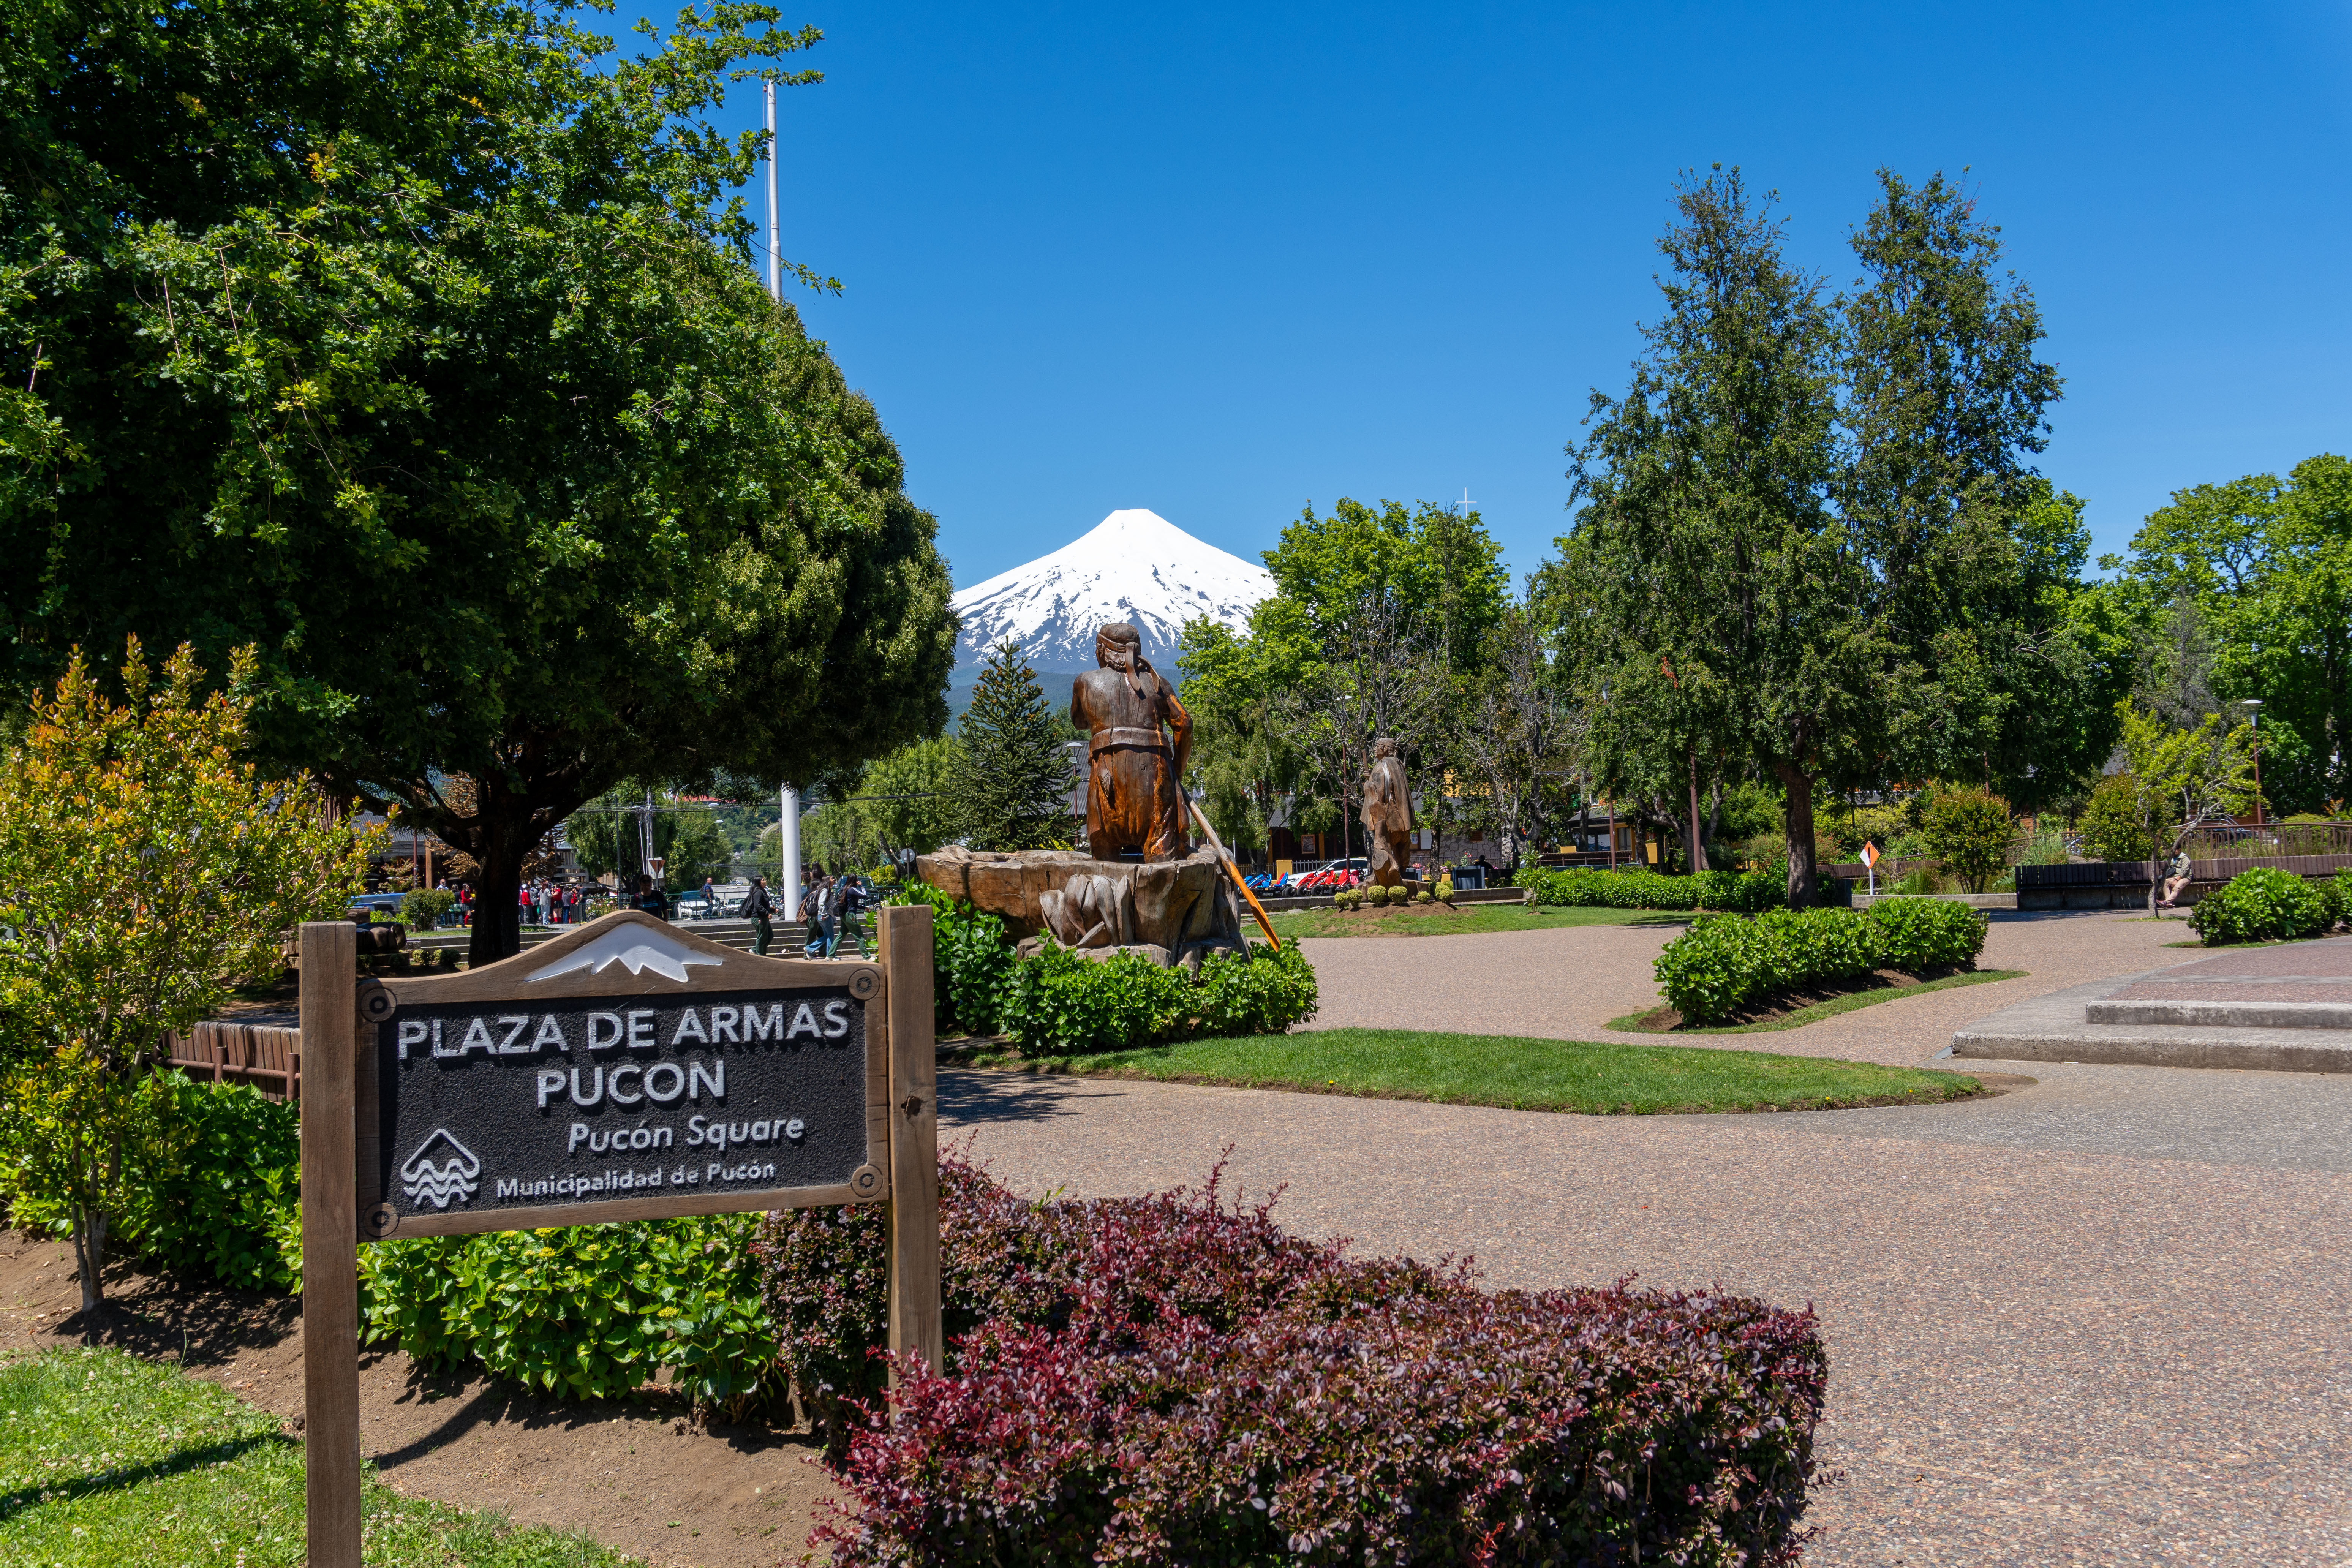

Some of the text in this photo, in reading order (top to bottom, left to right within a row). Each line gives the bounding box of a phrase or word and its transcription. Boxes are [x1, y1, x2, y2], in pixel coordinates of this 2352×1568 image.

[398, 1001, 848, 1059] PLAZA DE ARMAS
[537, 1060, 724, 1108] PUCON
[568, 1114, 804, 1152] Pucón Square
[497, 1160, 775, 1197] Municipalidad de Pucón
